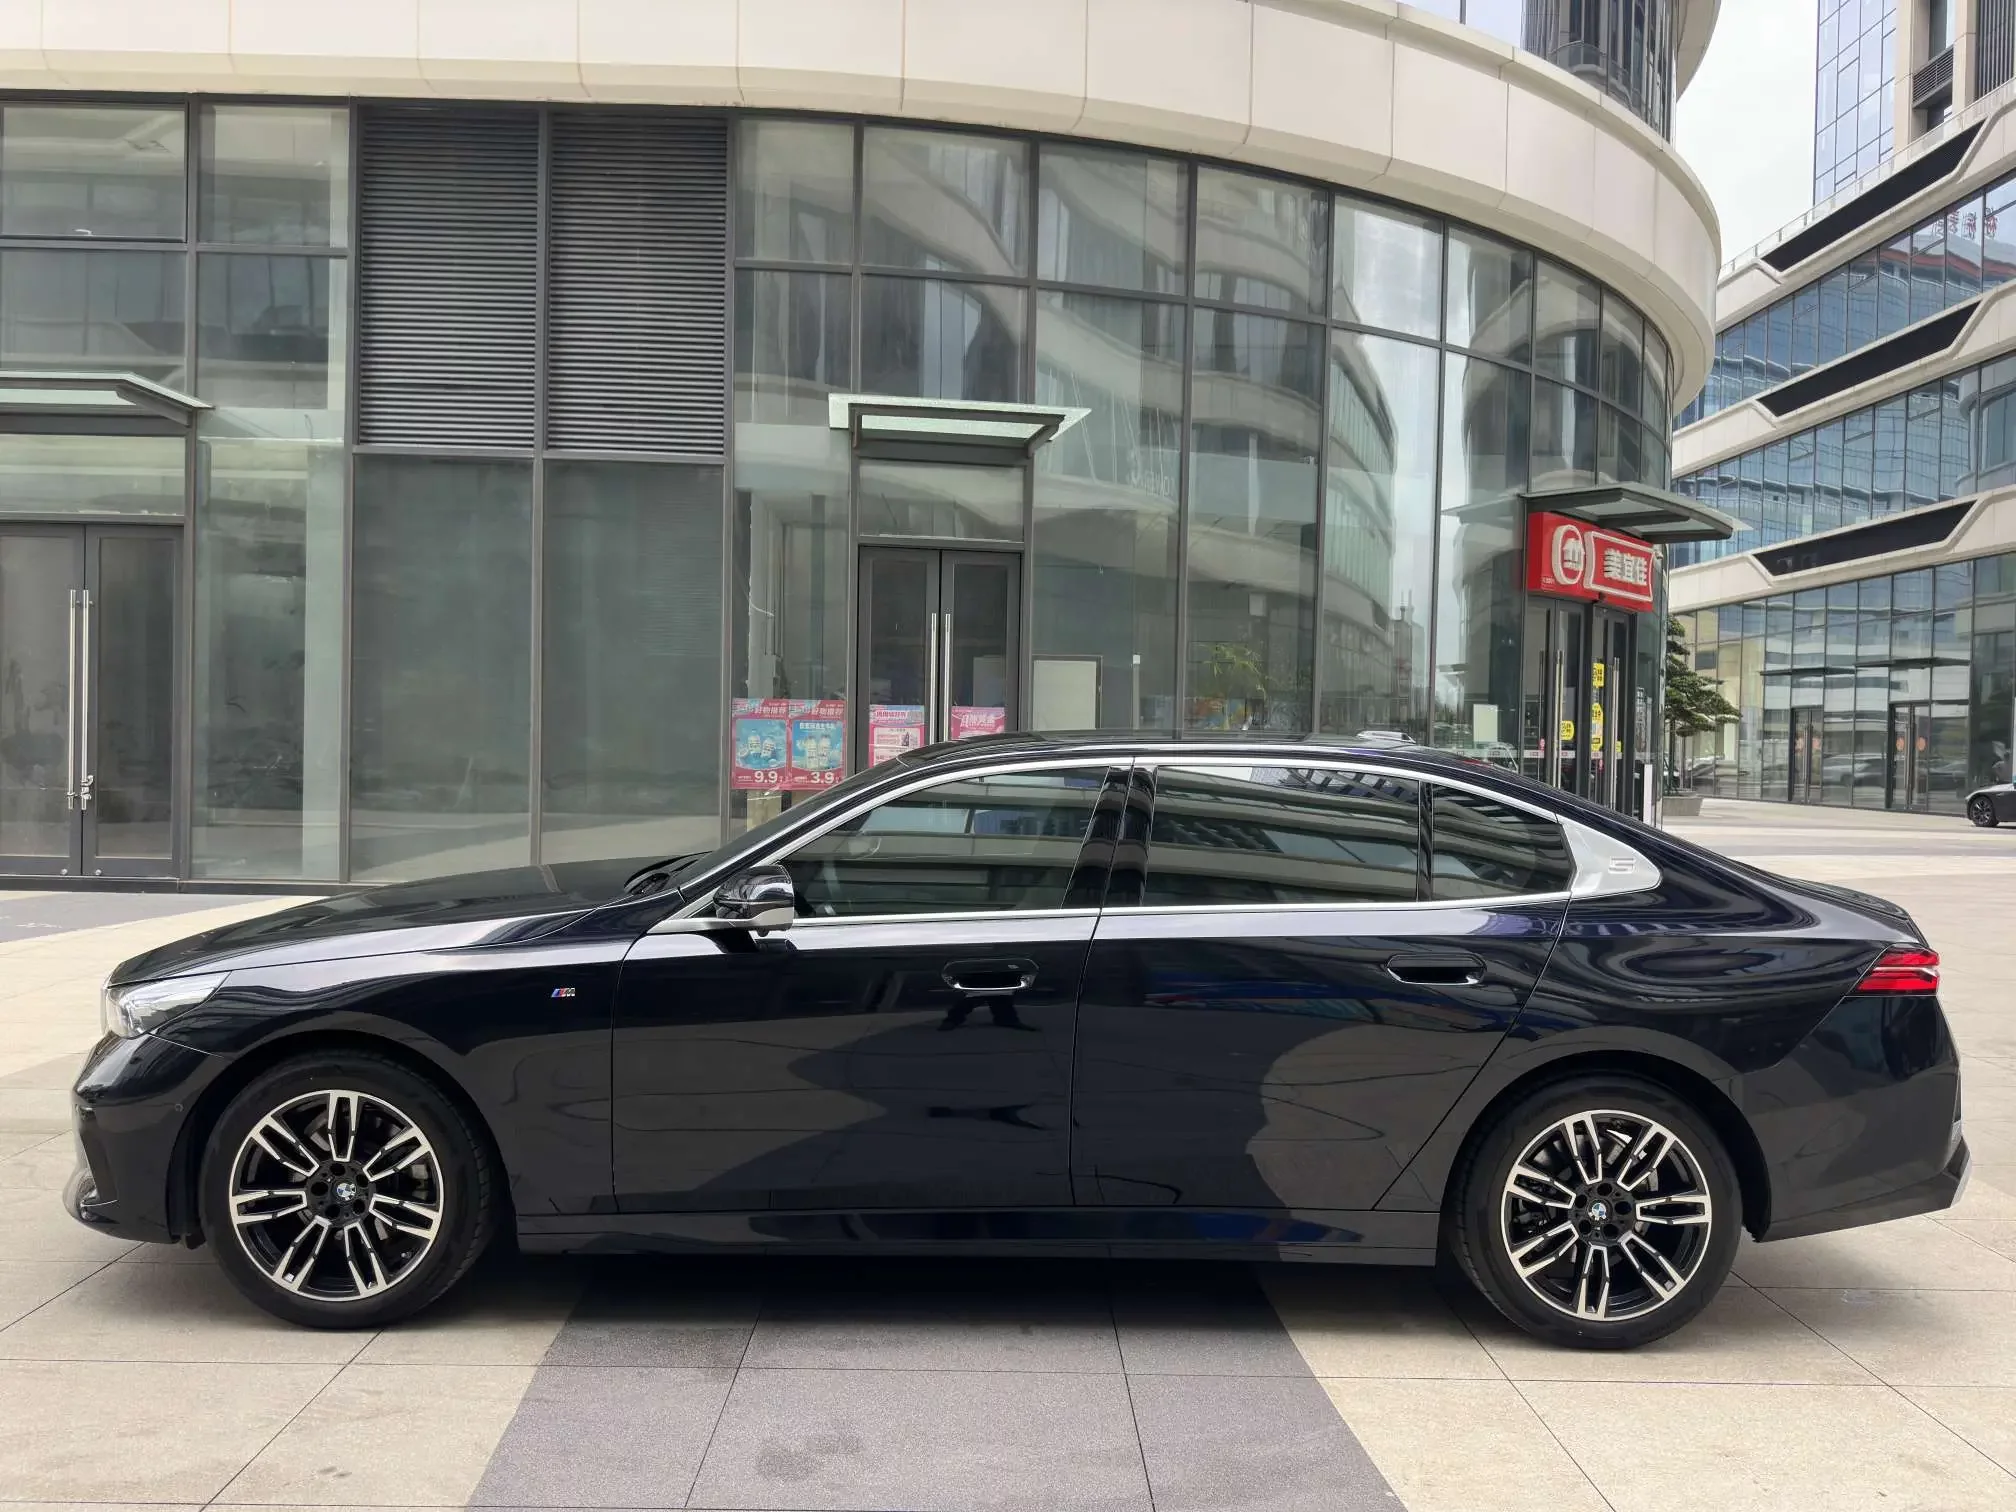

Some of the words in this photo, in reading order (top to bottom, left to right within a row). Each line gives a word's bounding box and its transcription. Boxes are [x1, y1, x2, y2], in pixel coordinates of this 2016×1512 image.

[1604, 548, 1647, 586] 美宜佳
[754, 770, 778, 783] 9.9
[810, 771, 835, 784] 3.9
[1608, 857, 1636, 875] 5
